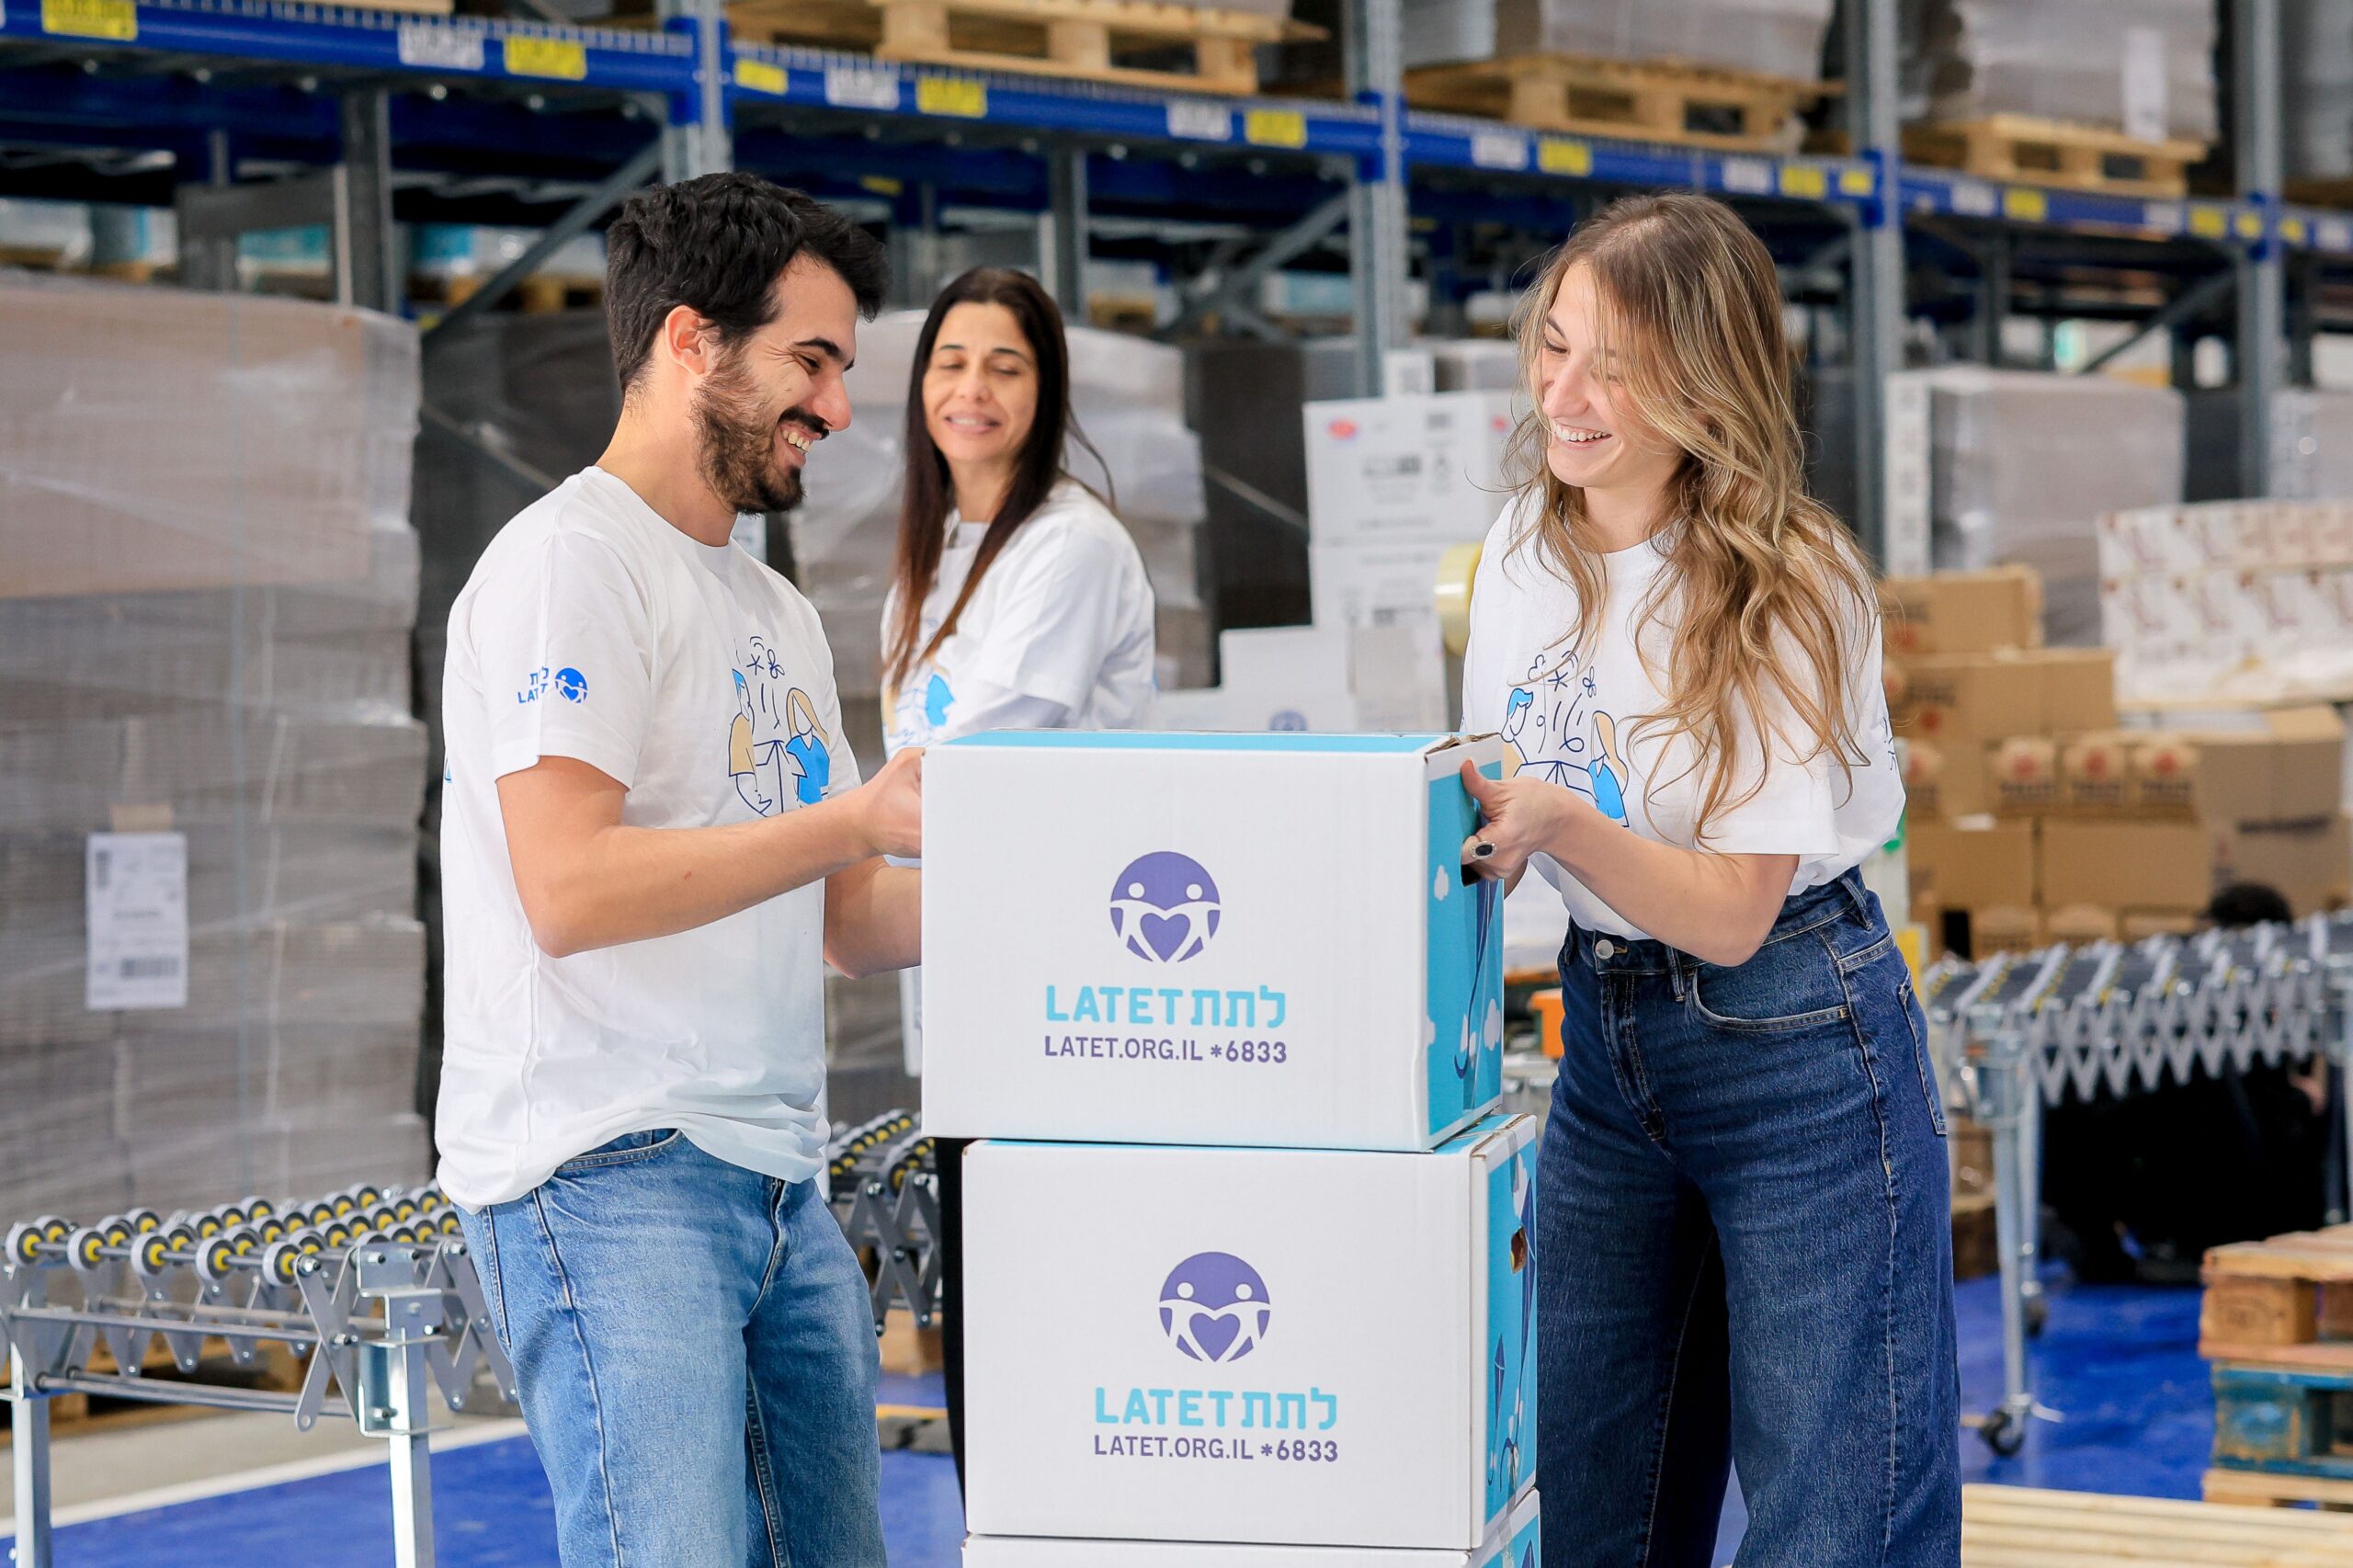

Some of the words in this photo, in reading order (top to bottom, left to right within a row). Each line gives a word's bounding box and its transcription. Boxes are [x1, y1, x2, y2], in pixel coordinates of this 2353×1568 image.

[1046, 984, 1184, 1025] LATET
[1190, 984, 1286, 1028] לתת
[1044, 1035, 1203, 1062] LATET.ORG.IL
[1095, 1386, 1234, 1426] LATET
[1240, 1386, 1337, 1430] לתת
[1094, 1434, 1254, 1460] LATET.ORG.IL
